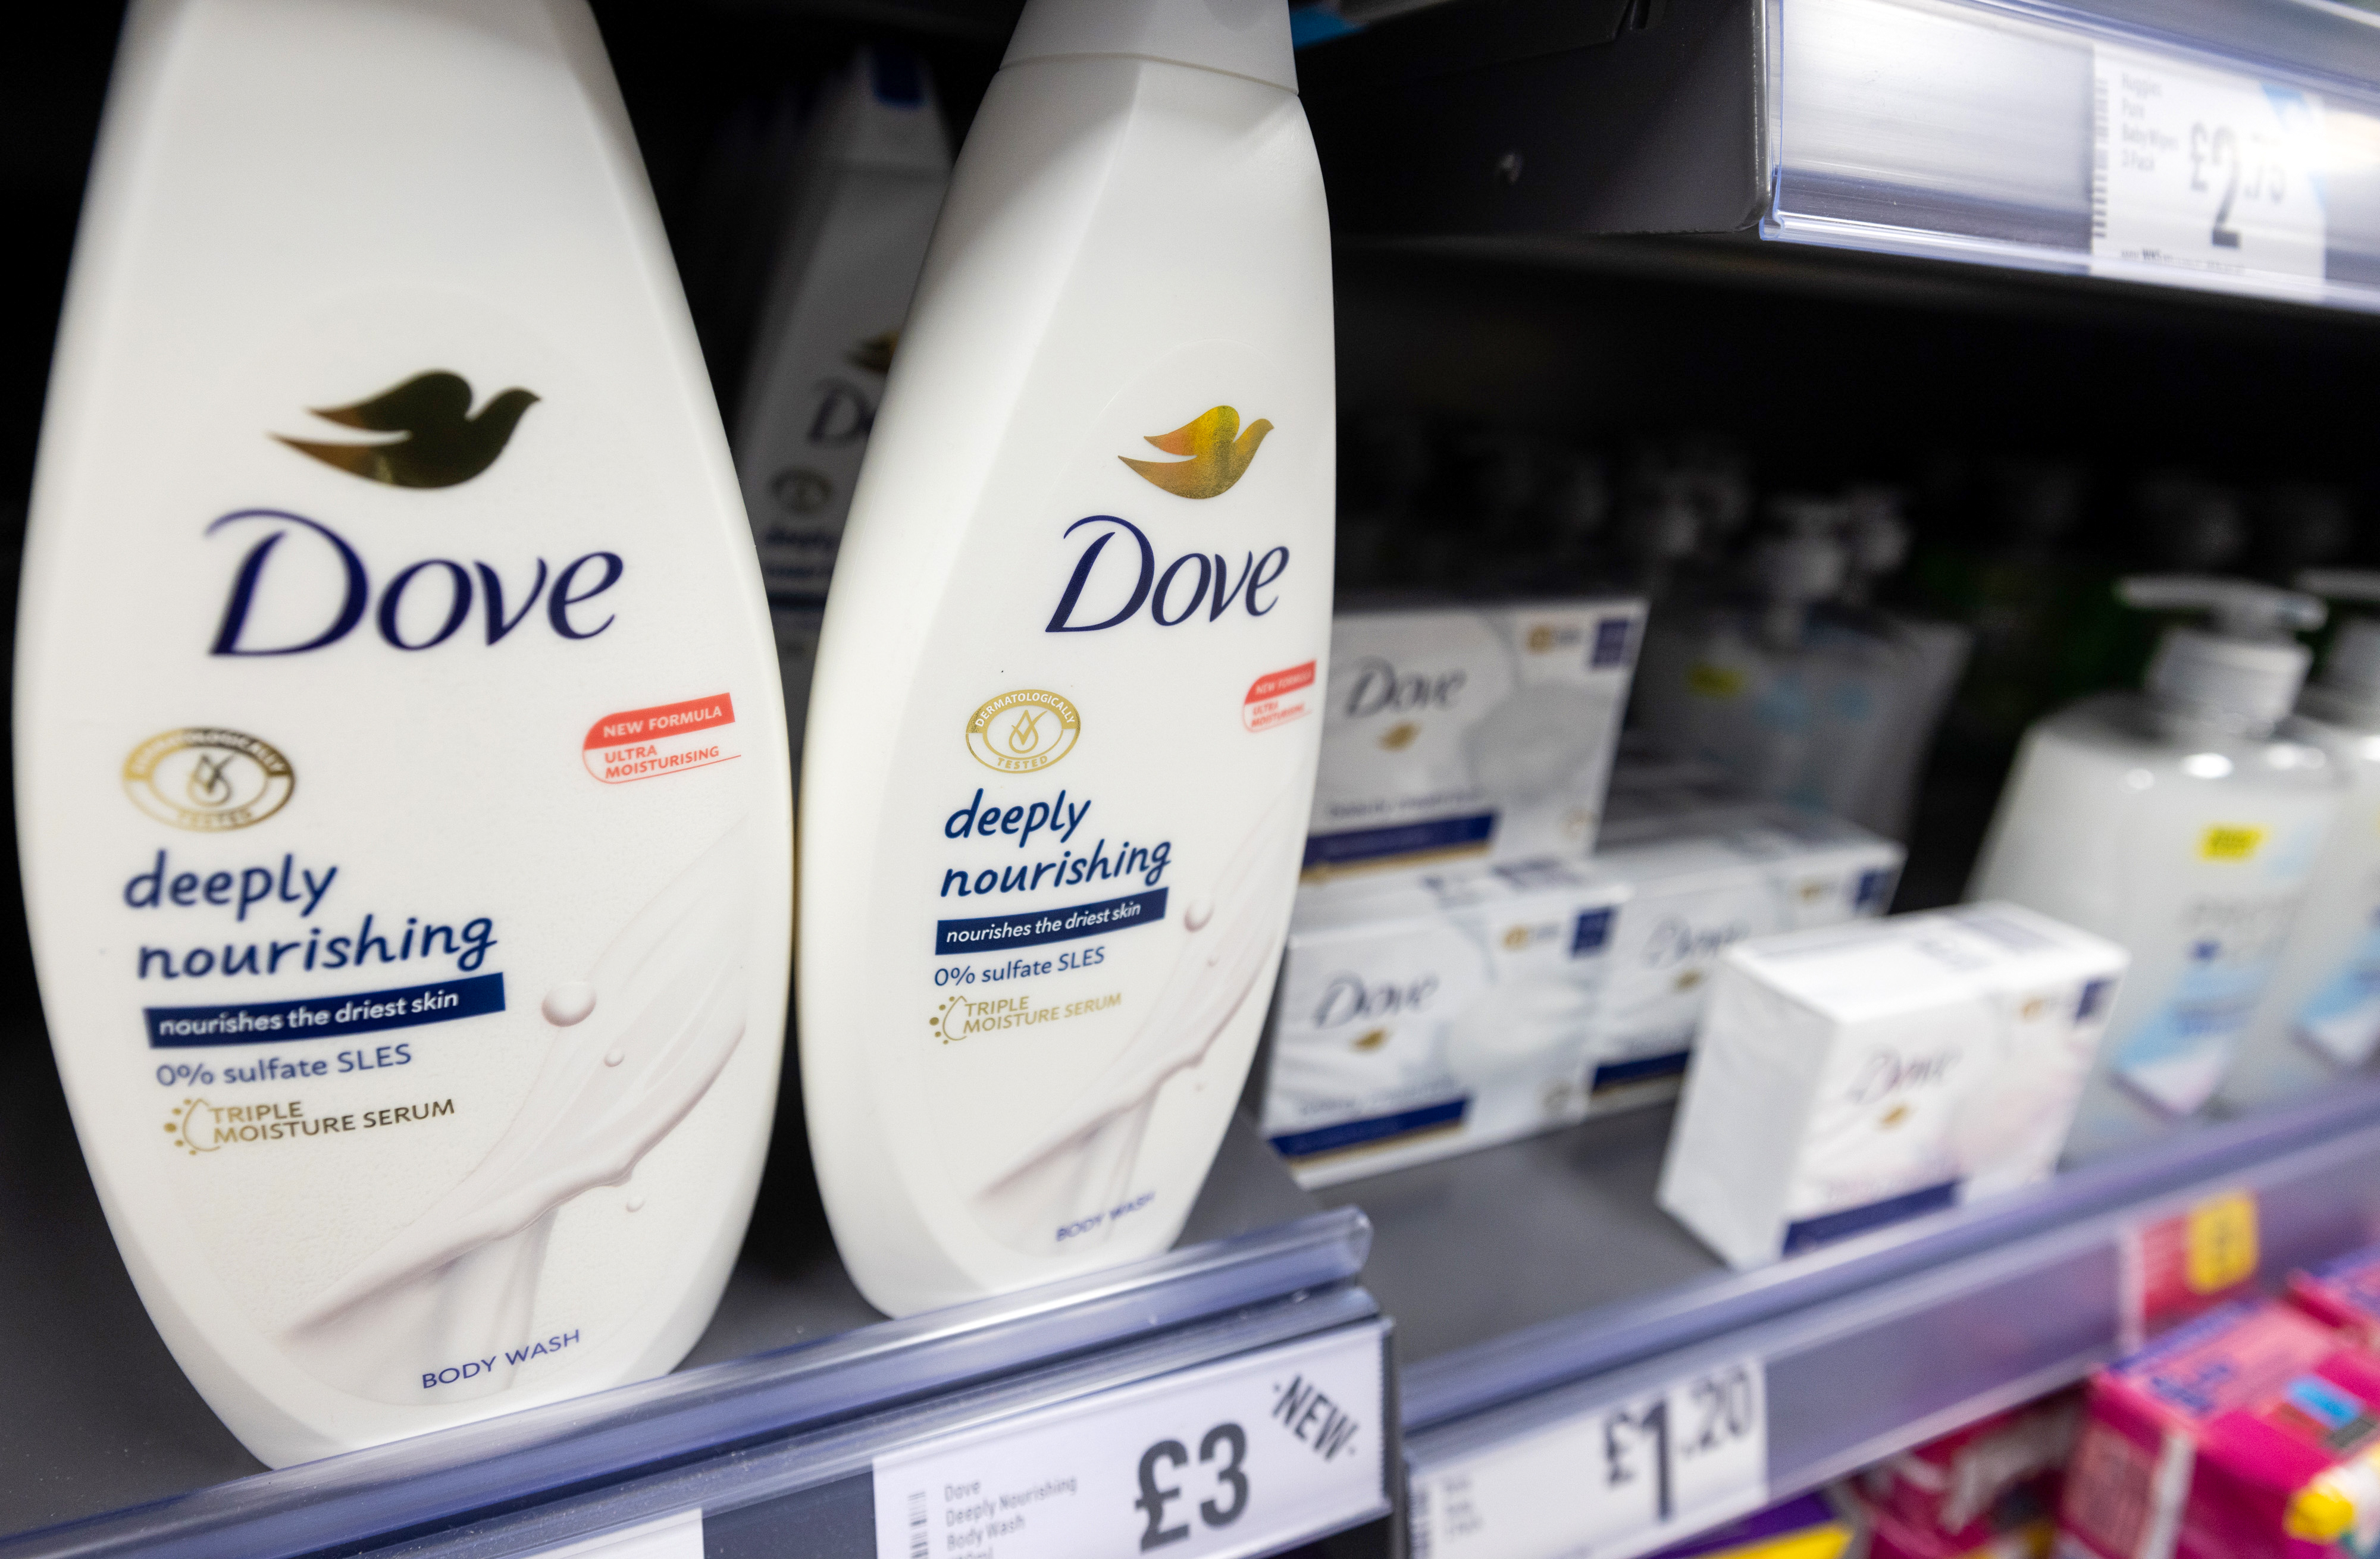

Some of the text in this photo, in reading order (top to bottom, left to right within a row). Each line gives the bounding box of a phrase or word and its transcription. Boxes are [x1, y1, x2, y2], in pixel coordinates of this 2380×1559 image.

[202, 509, 623, 658] Dove
[1045, 515, 1290, 633] Dove
[1344, 657, 1467, 717] Dove
[603, 706, 722, 738] NEW FORMULA
[975, 692, 1075, 727] DERMATOLOGICALLY
[605, 745, 657, 763] ULTRA
[605, 746, 719, 779] MOISTURISING
[997, 755, 1048, 769] TESTED
[945, 788, 1091, 848] deeply
[122, 849, 339, 923] deeply
[940, 838, 1172, 898] nourishing
[947, 902, 1141, 943] nourishes the driest skin
[137, 913, 498, 979] nourishing
[934, 946, 1106, 986] 0% sulfate SLES
[159, 989, 459, 1036] nourishes the driest skin
[963, 992, 1122, 1034] MOISTURE SERUM
[964, 996, 1029, 1017] TRIPLE
[156, 1043, 412, 1087] 0% sulfate SLES
[208, 1101, 303, 1124] TRIPLE
[214, 1099, 455, 1144] MOISTURE SERUM
[422, 1329, 579, 1388] BODY WASH
[1270, 1374, 1361, 1463] NEW
[944, 1479, 981, 1502] Dove
[946, 1476, 1078, 1526] Deeply Nourishing
[1135, 1421, 1249, 1555] £3
[947, 1513, 1026, 1551] Body Wash
